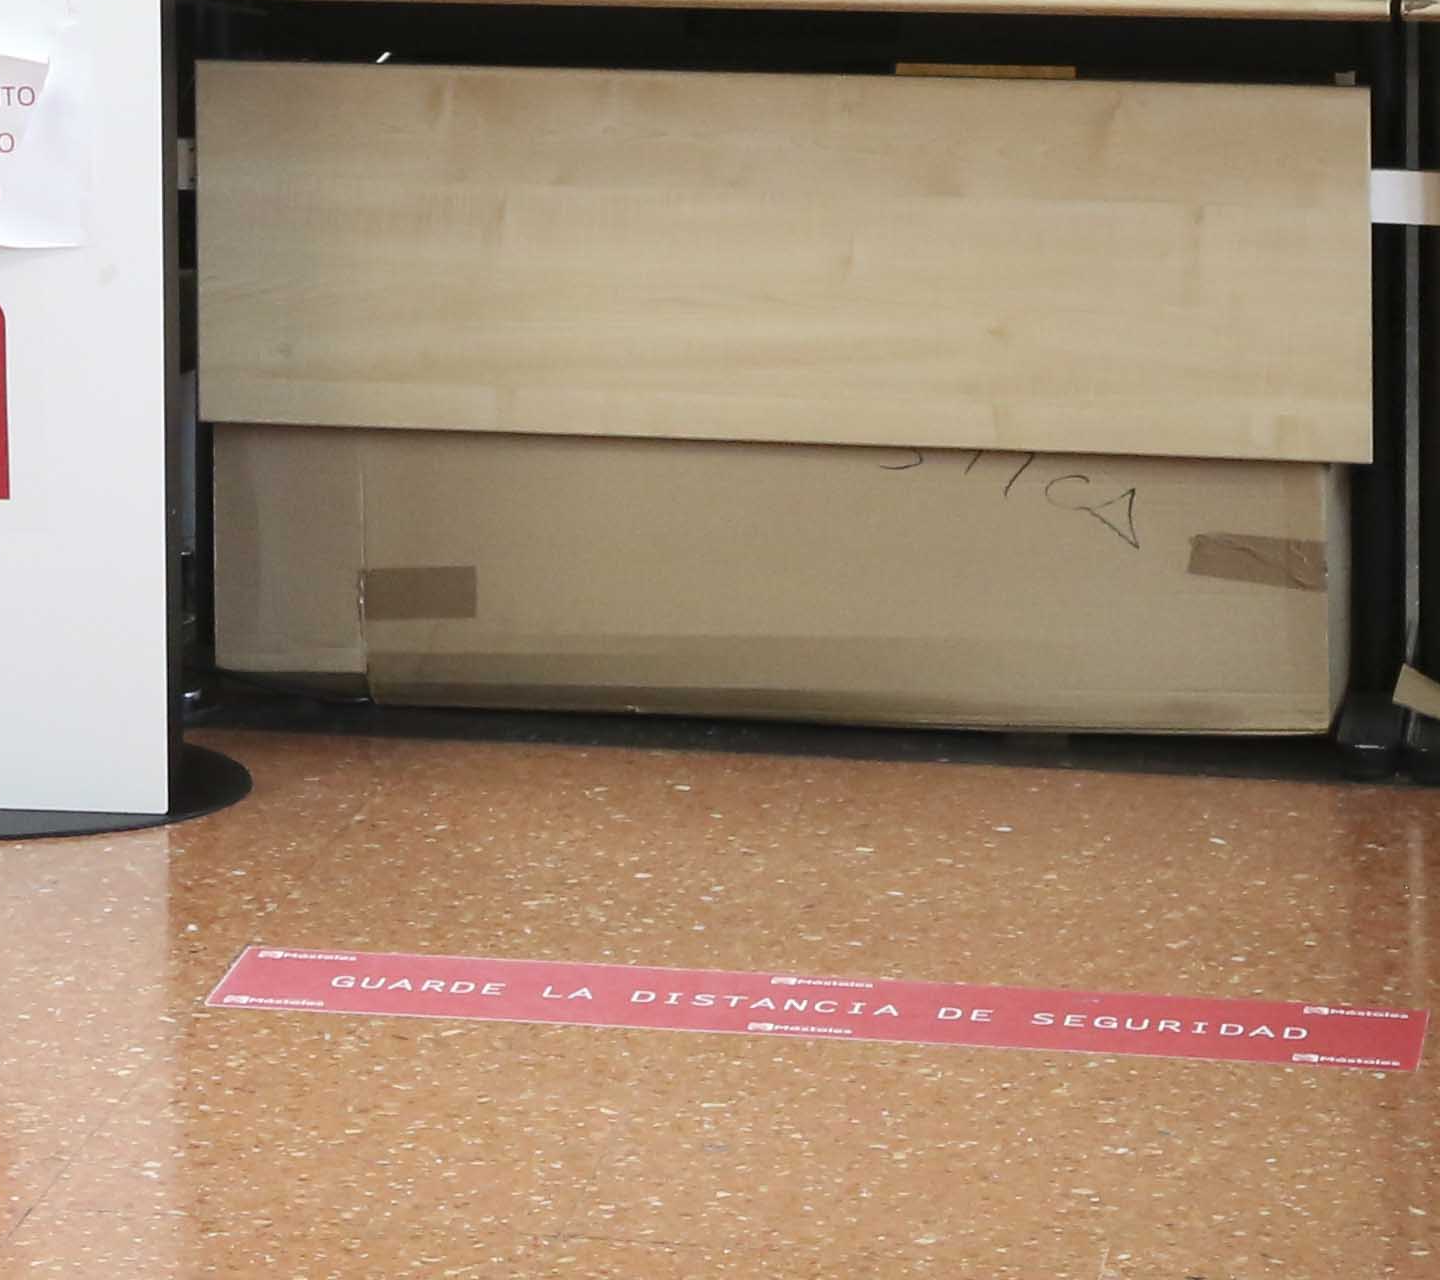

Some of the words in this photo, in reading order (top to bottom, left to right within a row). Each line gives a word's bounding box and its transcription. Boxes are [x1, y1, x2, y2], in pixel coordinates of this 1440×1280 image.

[331, 975, 507, 997] GUARDE
[540, 985, 594, 1001] LA
[630, 990, 900, 1018] DISTANCIA
[937, 1006, 994, 1022] DE
[1031, 1012, 1309, 1041] SEGURIDAD
